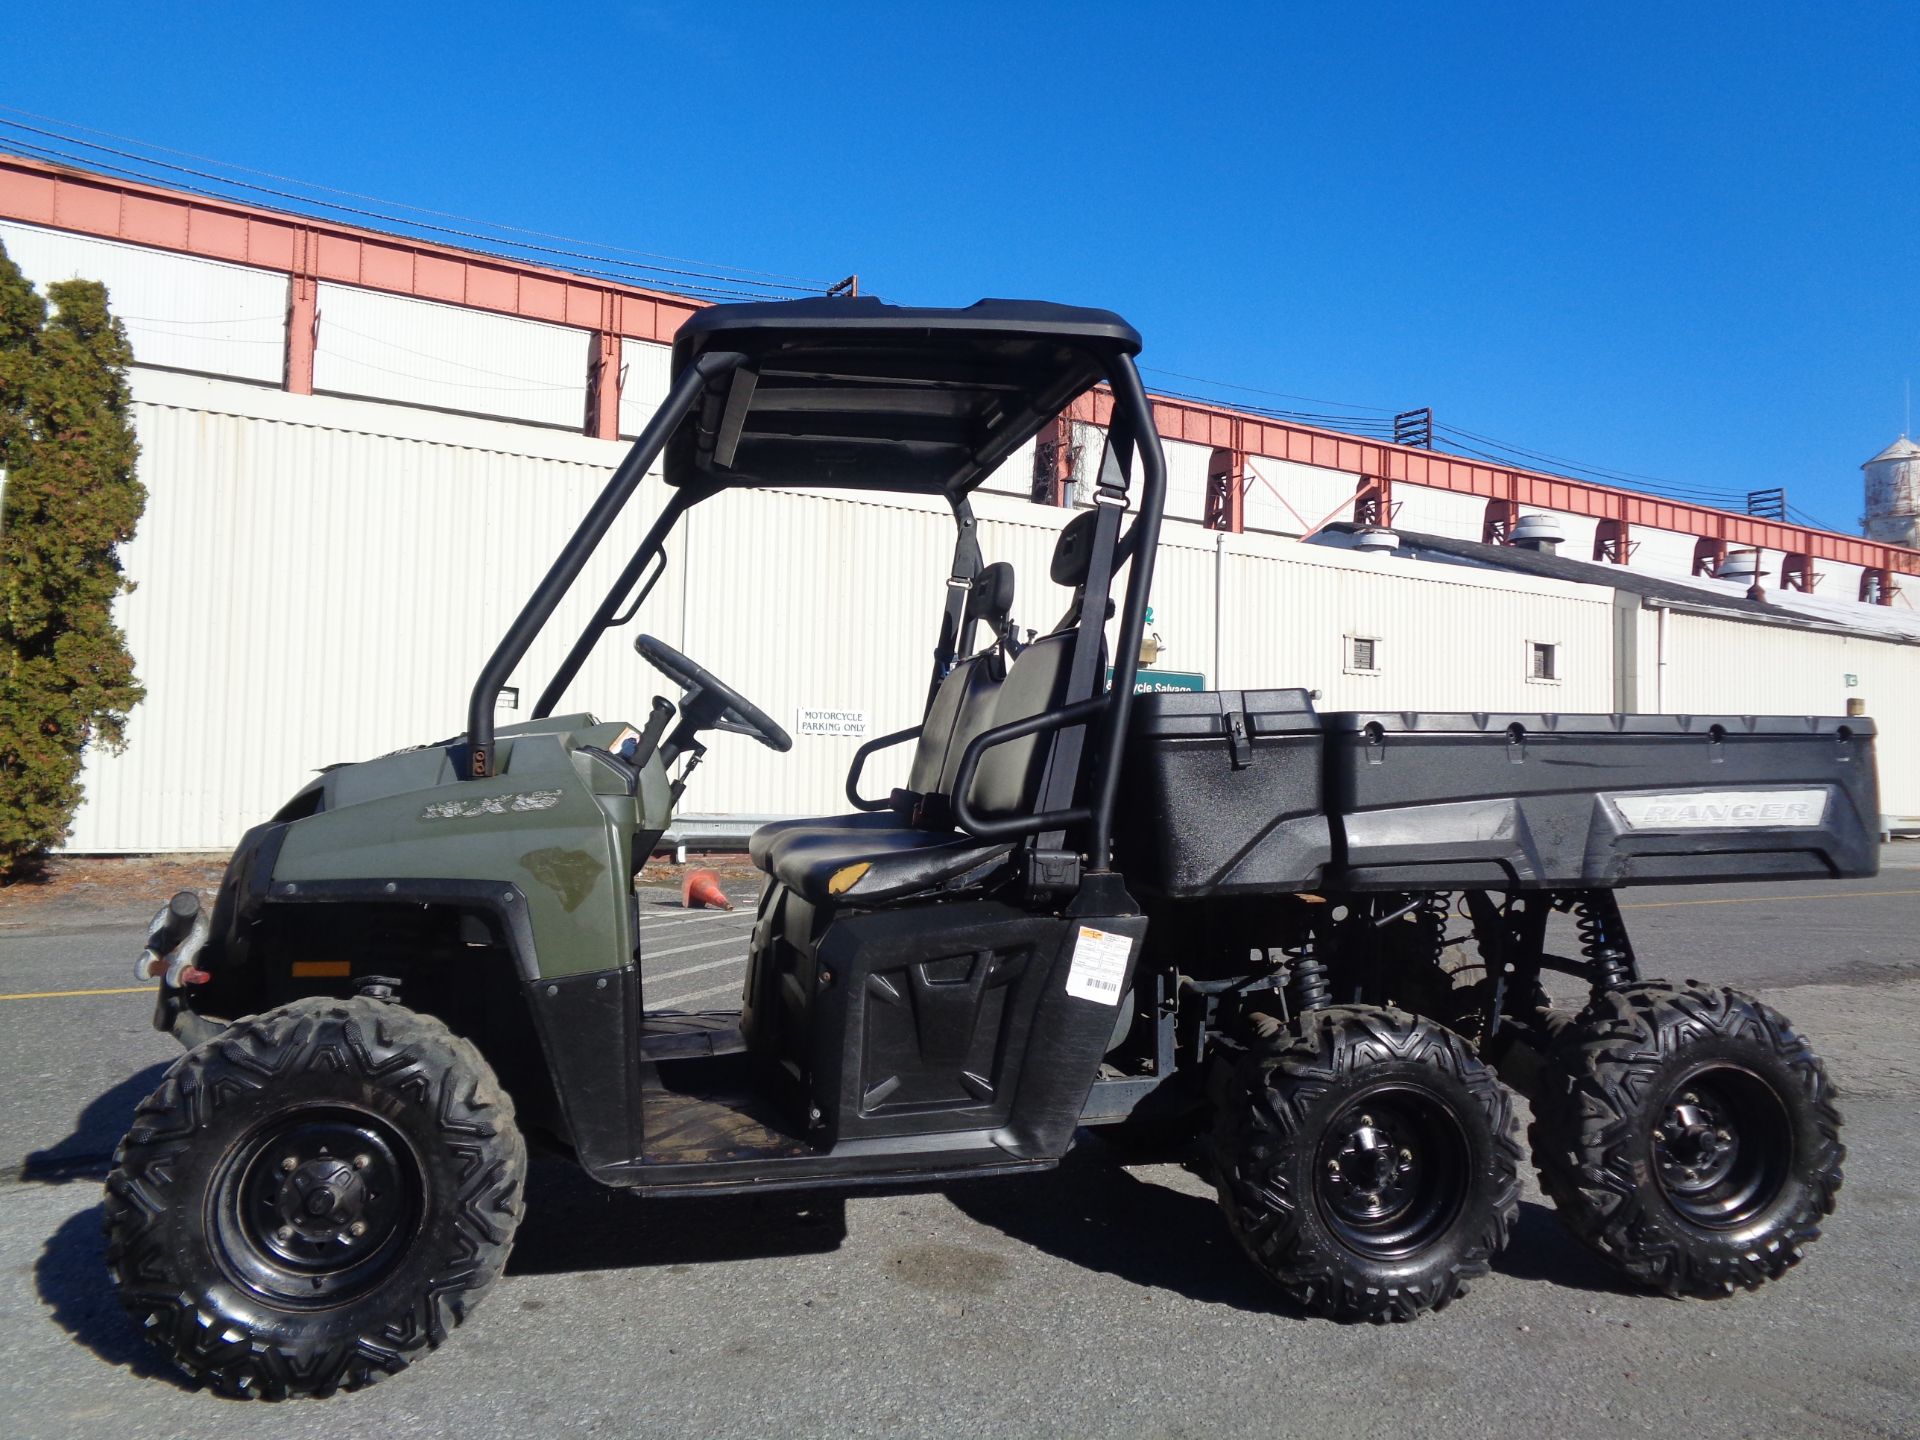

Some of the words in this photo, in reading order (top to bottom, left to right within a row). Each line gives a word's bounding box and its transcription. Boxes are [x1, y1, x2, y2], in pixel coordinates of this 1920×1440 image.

[1133, 683, 1153, 696] ycle
[805, 711, 863, 721] MOTORCYCLE
[802, 722, 841, 731] PARKING
[843, 723, 866, 732] ONLY
[1644, 803, 1809, 822] RANGER
